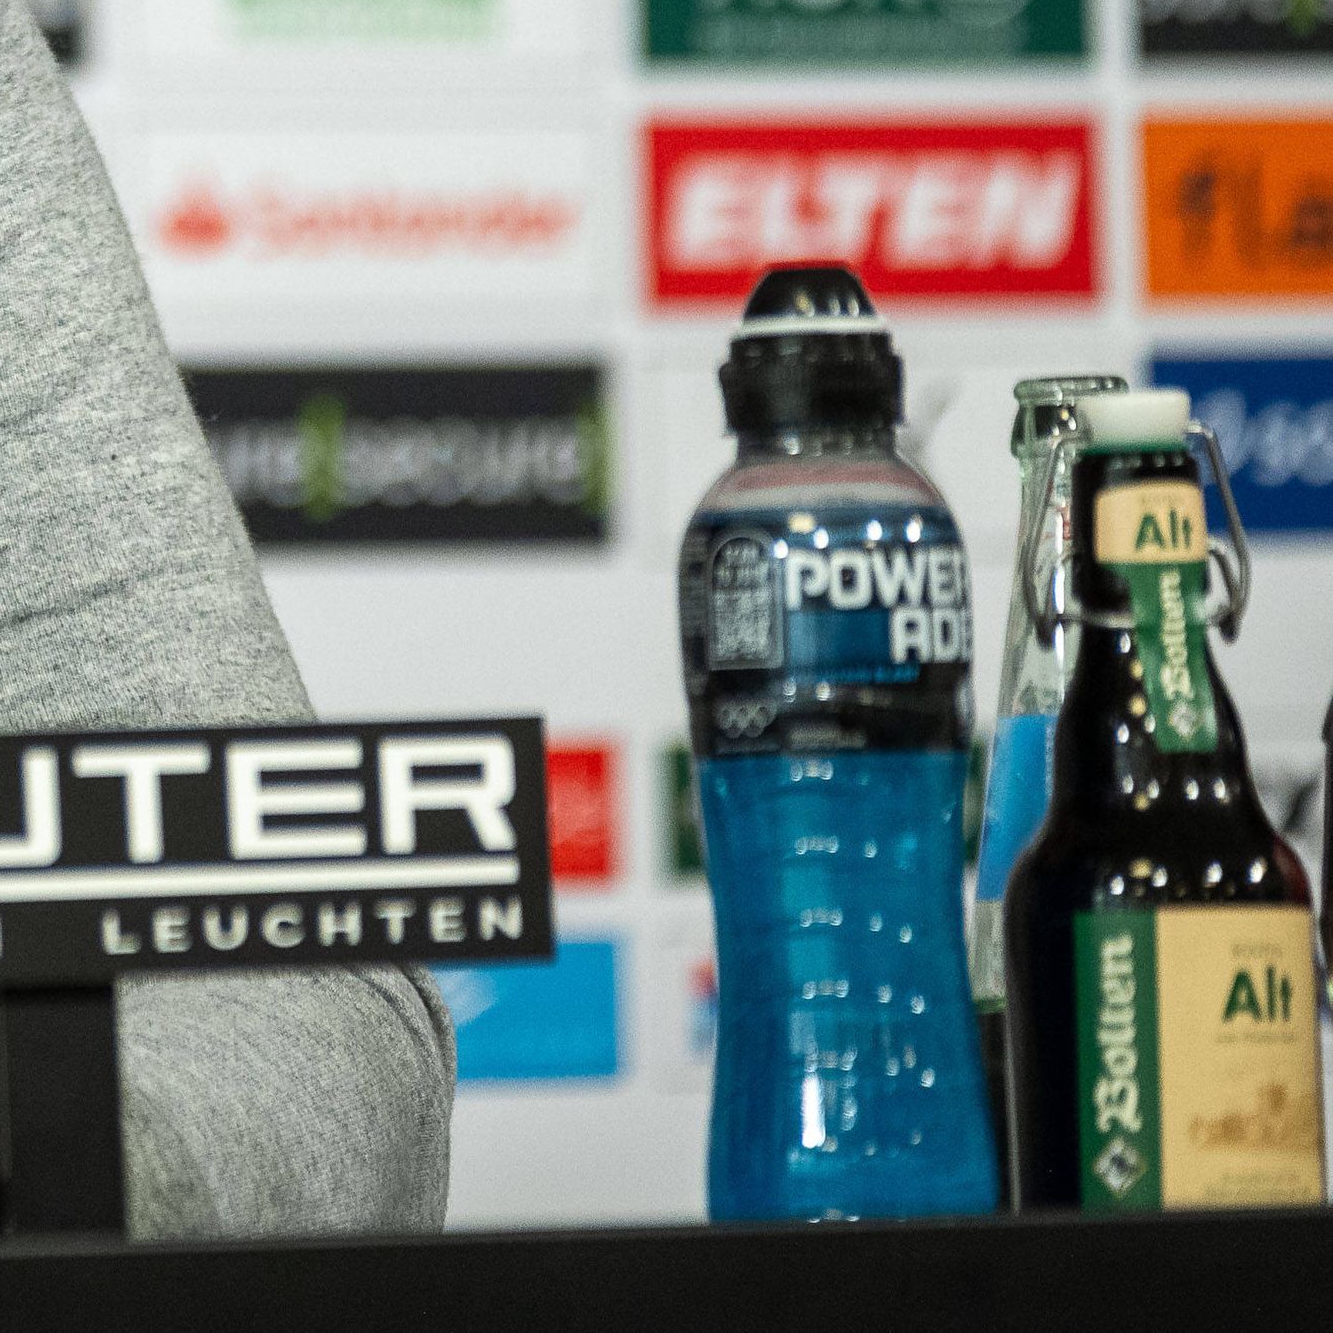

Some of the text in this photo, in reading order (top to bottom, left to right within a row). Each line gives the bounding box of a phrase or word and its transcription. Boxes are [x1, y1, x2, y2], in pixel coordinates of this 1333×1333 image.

[665, 151, 1079, 270] ELTEN
[1135, 507, 1193, 552] Alt
[103, 896, 526, 957] LEUCHTEN
[1221, 964, 1293, 1023] Alt
